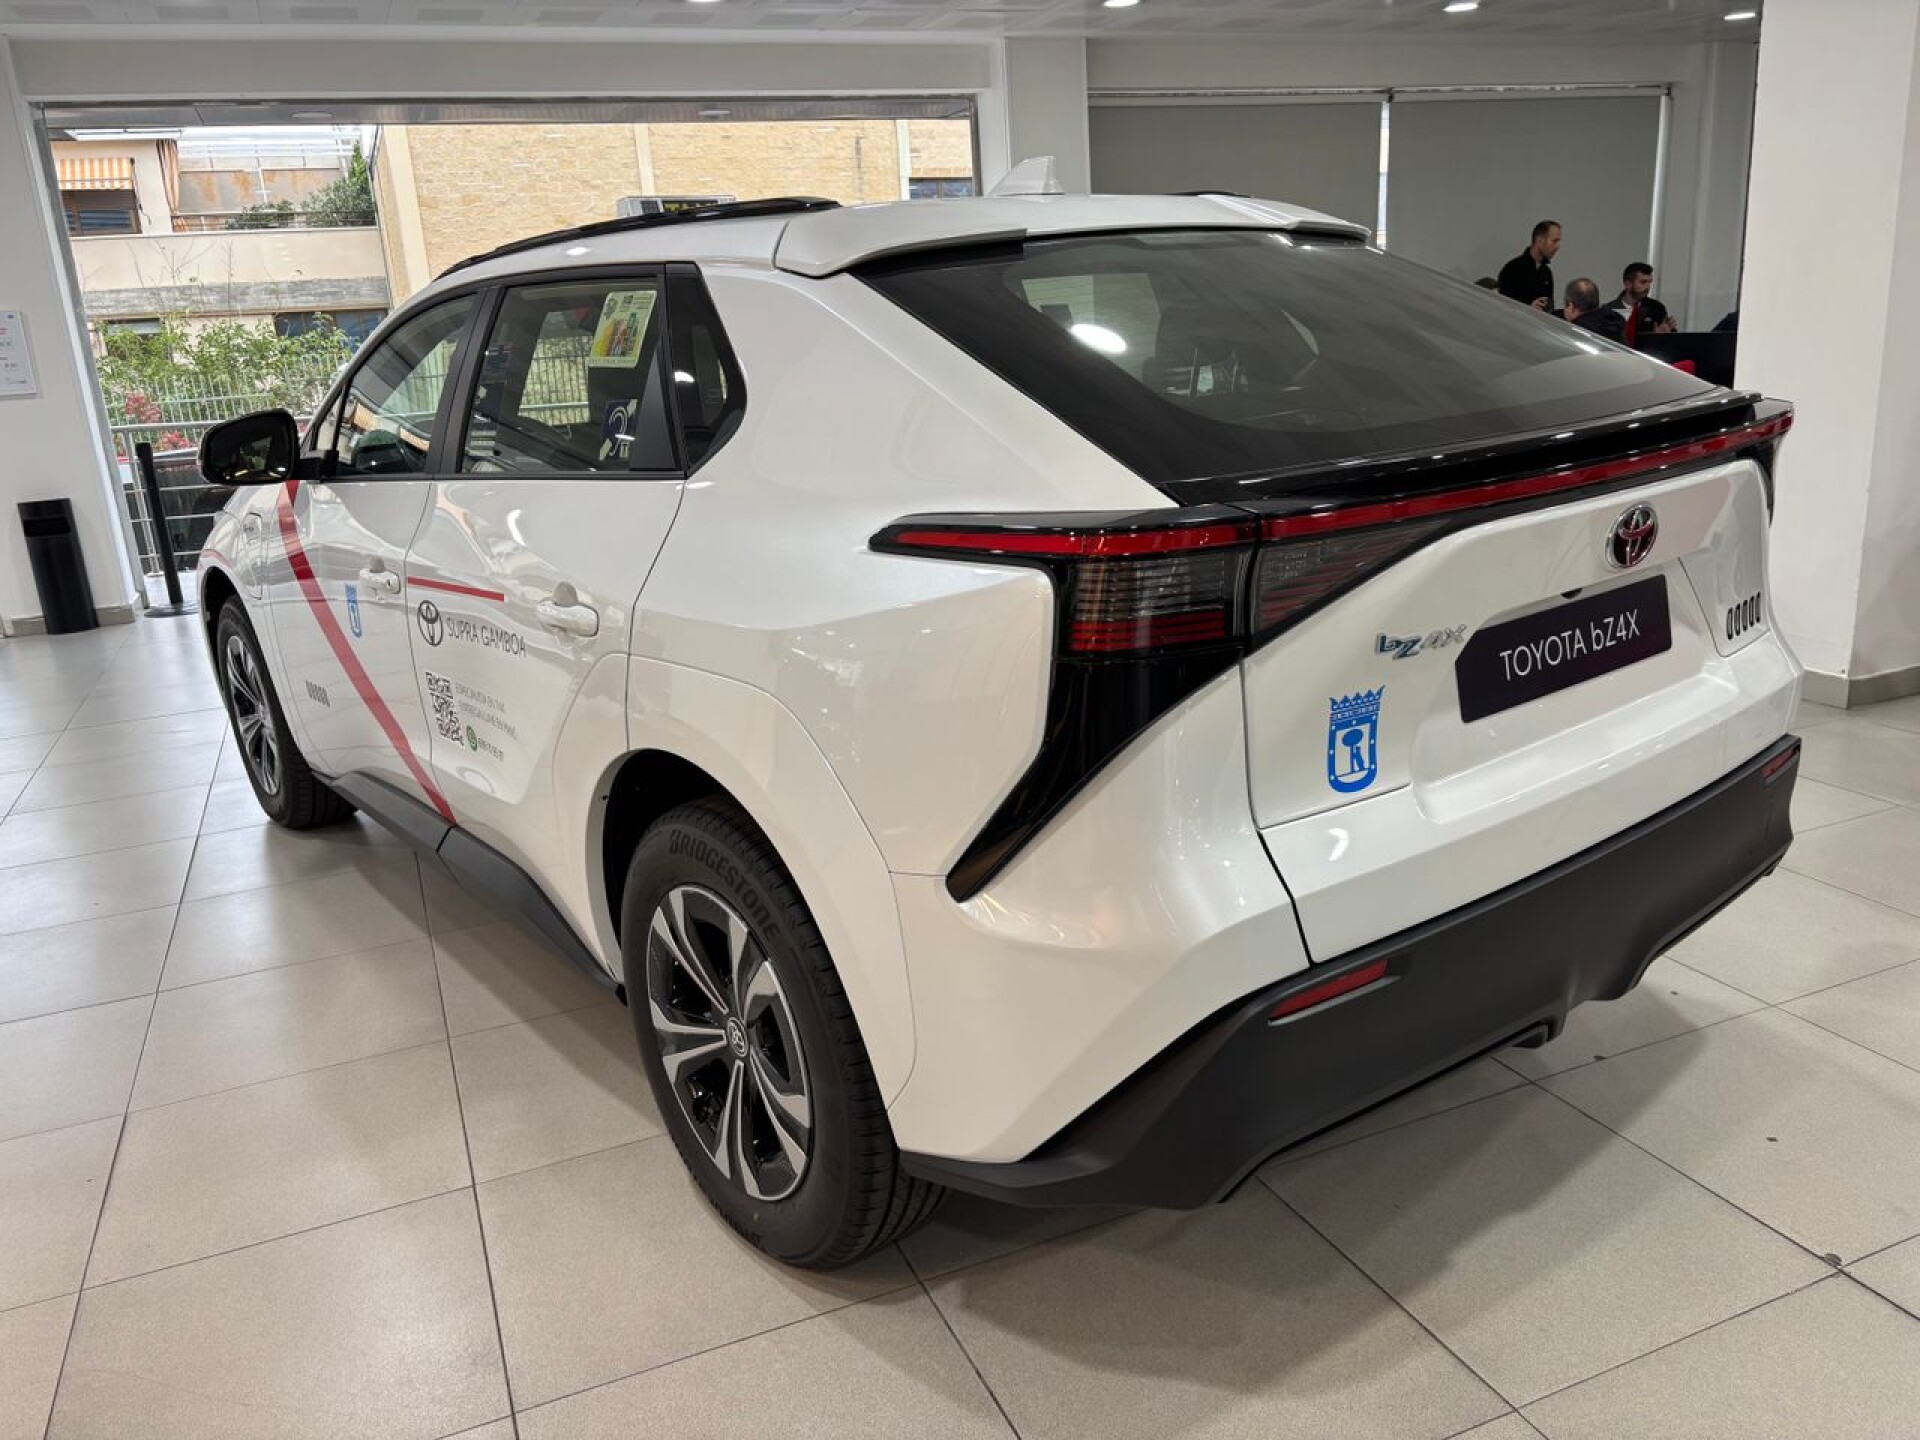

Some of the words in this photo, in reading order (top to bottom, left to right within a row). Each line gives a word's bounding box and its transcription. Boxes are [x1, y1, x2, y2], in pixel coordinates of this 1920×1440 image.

[446, 618, 479, 643] SUPRA
[481, 625, 527, 657] GAMBOA
[1500, 628, 1587, 681] TOYOTA
[1590, 608, 1640, 651] bZ4X
[669, 829, 781, 941] BRIDGESTONE
